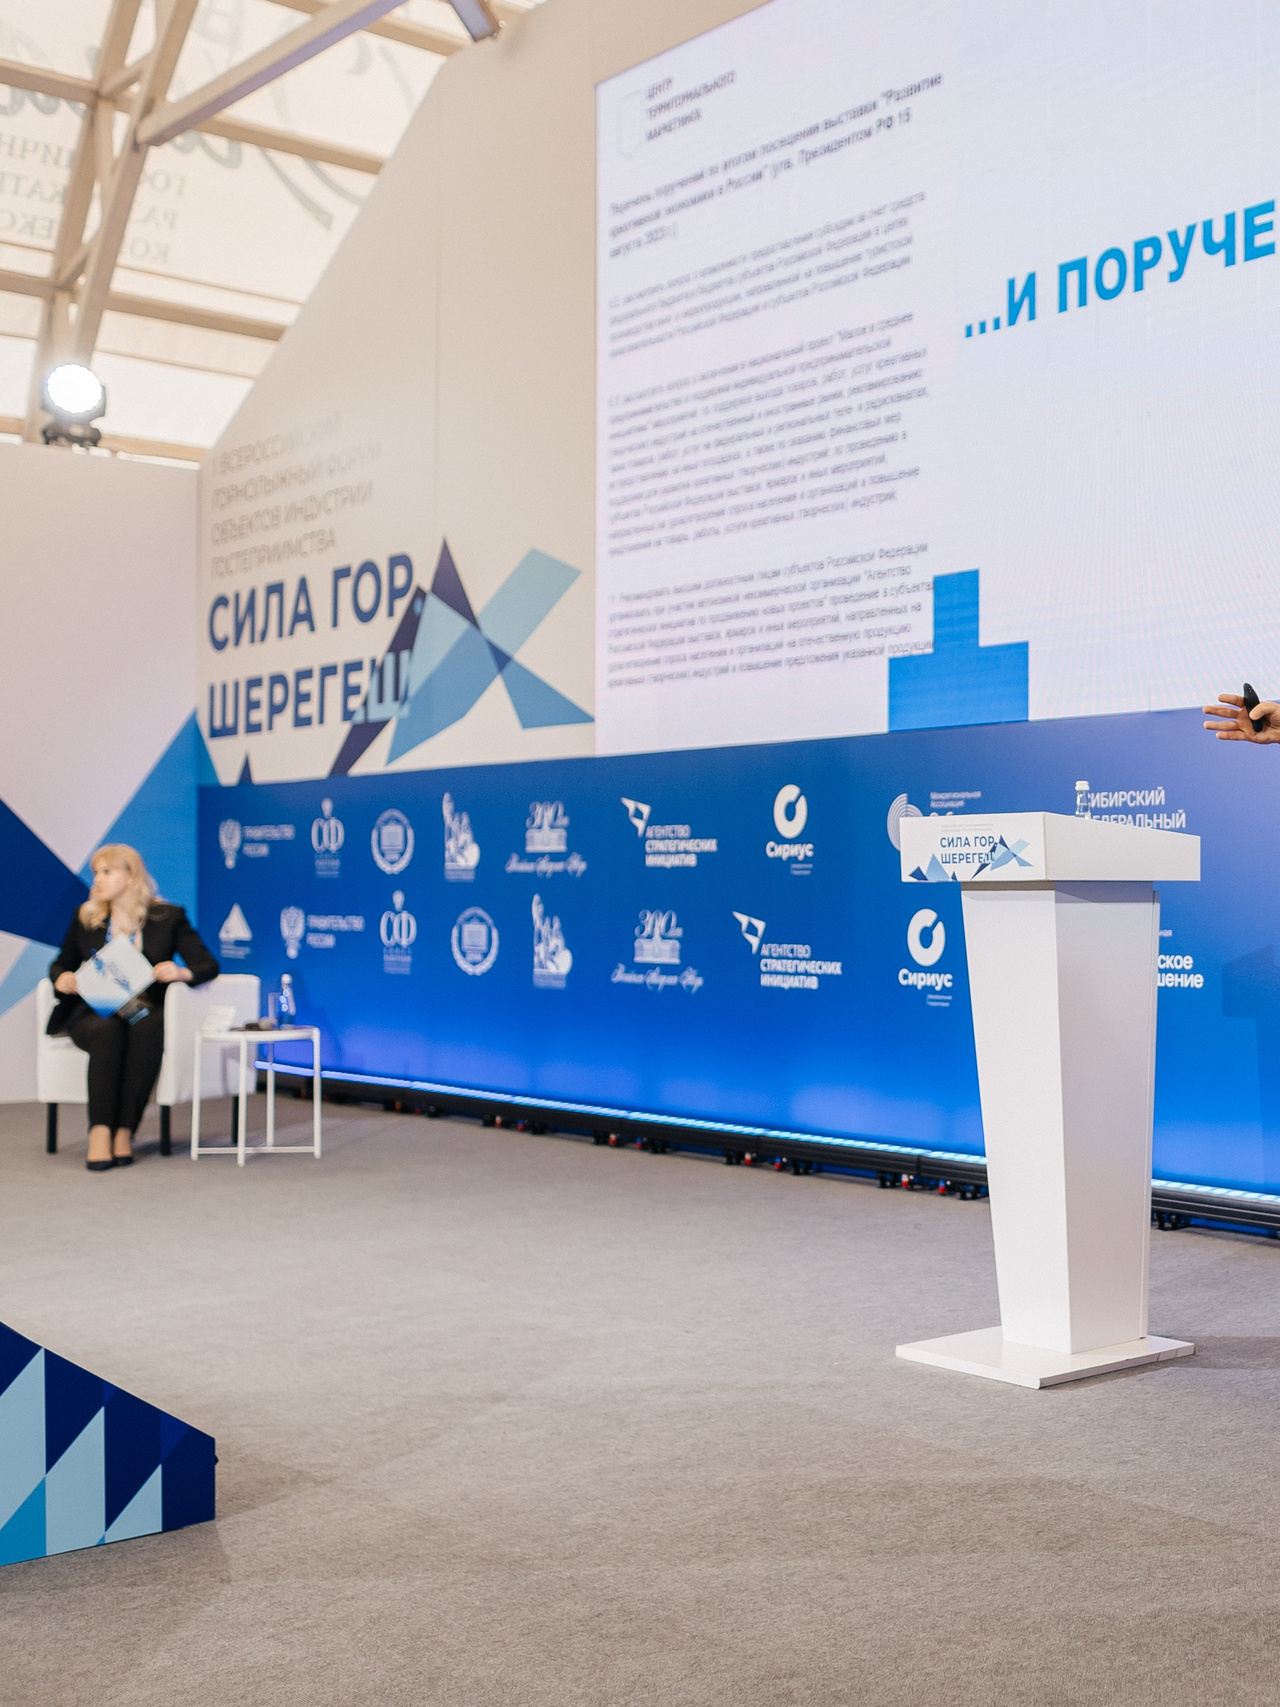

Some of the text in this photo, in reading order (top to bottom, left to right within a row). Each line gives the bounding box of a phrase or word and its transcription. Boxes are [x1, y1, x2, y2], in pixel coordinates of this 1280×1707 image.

[965, 271, 1037, 338] ...И
[208, 553, 414, 652] СИЛА ГОР
[1089, 786, 1166, 808] ИБИРСКИЙ
[646, 825, 691, 839] АГЕНТСТВО
[645, 839, 719, 854] СТРАТЕГИЧЕСКИХ
[940, 836, 995, 848] СИЛА ГОР
[765, 841, 815, 861] Сириус
[645, 853, 698, 868] ИНИЦИАТИВ
[760, 944, 812, 959] АГЕНТСТВО
[760, 959, 843, 975] СТРАТЕГИЧЕСКИХ
[760, 973, 820, 989] ИНИЦИАТИВ
[898, 967, 954, 992] Сириус
